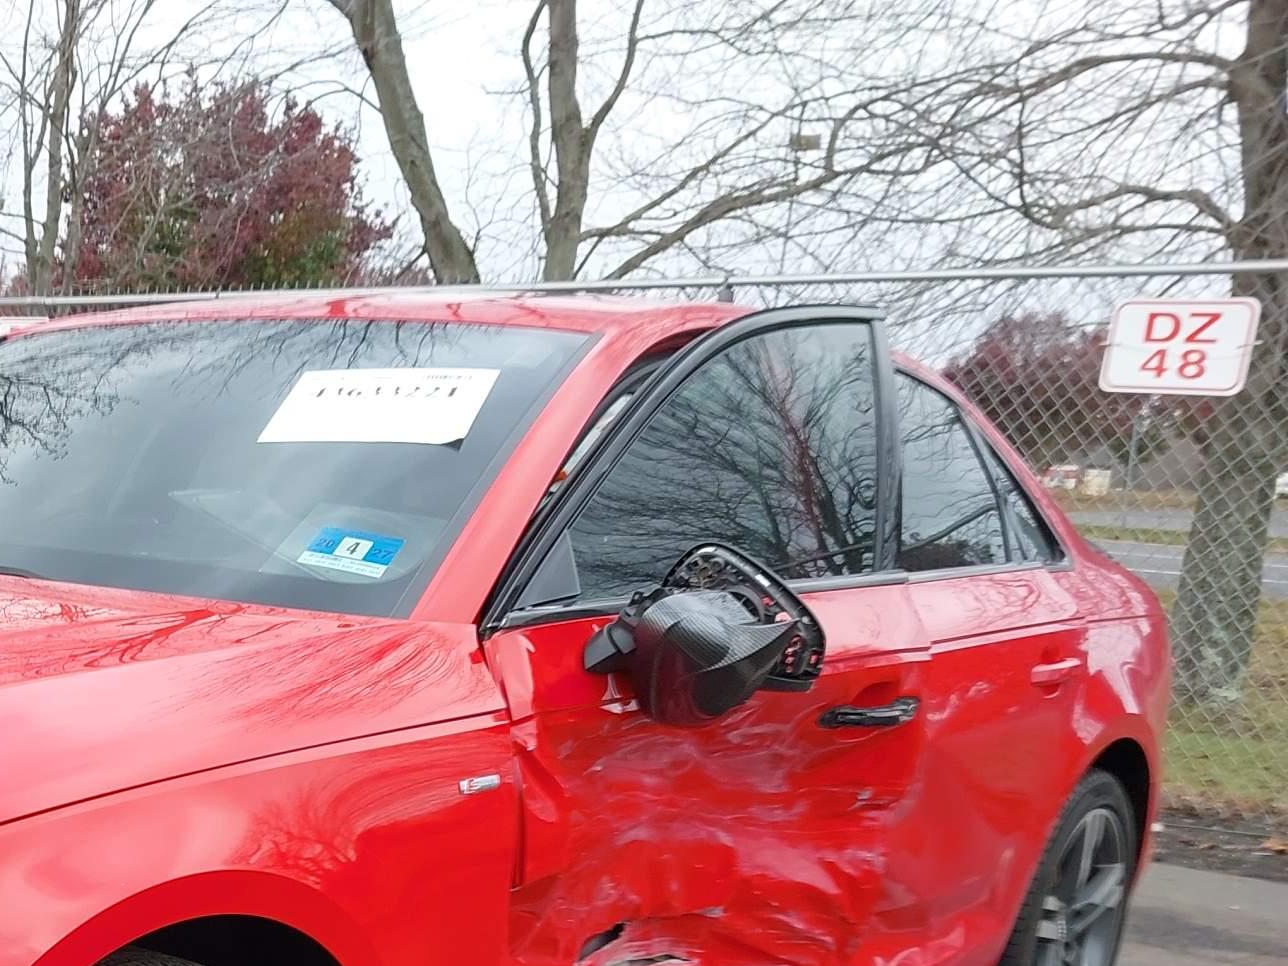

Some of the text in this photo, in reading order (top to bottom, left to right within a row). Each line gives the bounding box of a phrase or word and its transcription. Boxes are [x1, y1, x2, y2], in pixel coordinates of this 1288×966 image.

[1143, 312, 1222, 344] DZ
[1140, 348, 1207, 379] 48
[345, 541, 361, 555] 4
[372, 548, 393, 560] 27
